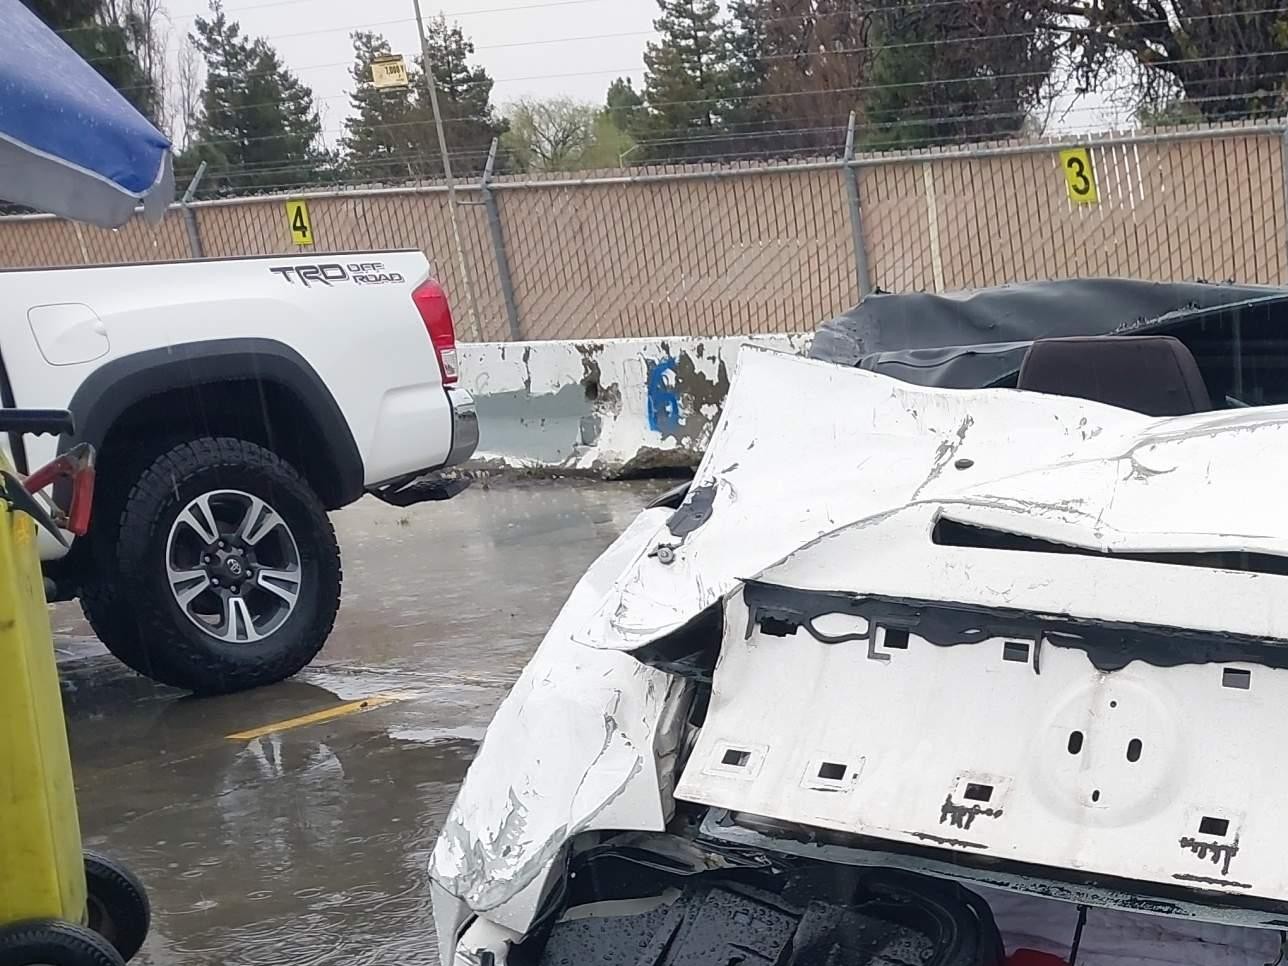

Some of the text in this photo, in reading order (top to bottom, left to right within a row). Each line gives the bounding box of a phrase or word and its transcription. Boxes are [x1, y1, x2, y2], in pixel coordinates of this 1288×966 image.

[1067, 156, 1090, 196] 3
[292, 205, 308, 238] 4
[269, 263, 350, 288] TRD
[346, 262, 385, 274] OFF
[352, 272, 406, 284] ROAD
